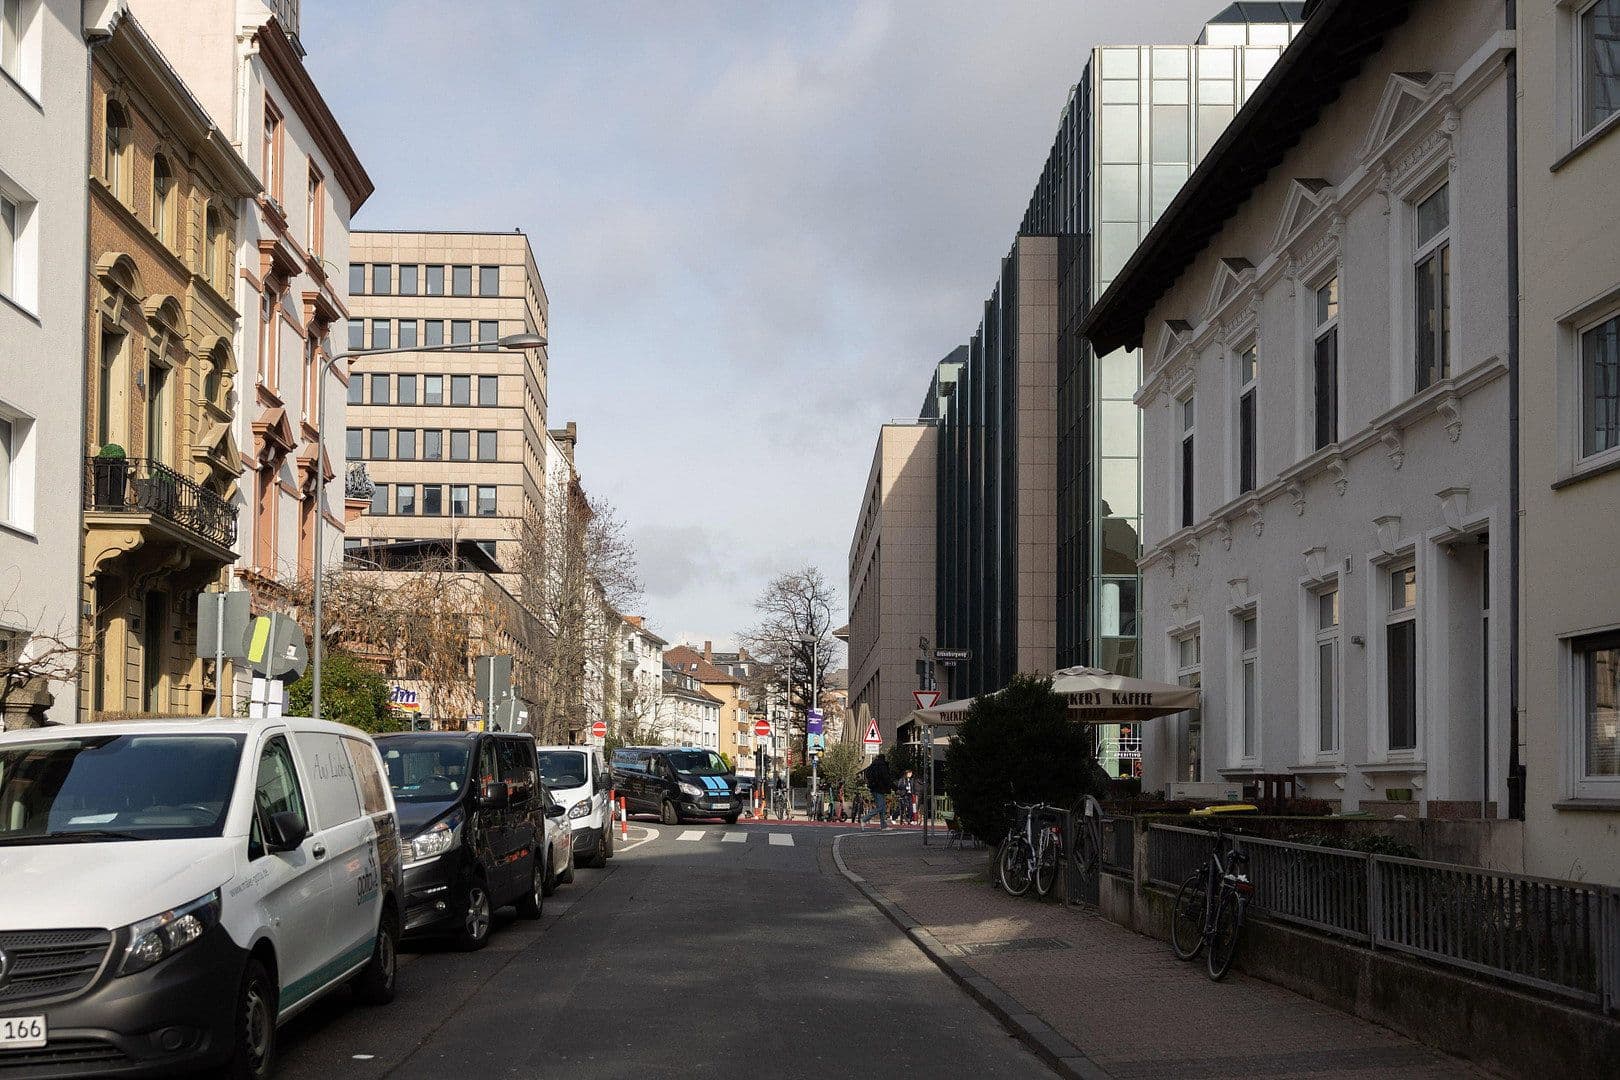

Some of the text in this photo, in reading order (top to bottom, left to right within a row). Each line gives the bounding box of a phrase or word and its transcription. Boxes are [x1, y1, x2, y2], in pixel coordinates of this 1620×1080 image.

[390, 685, 416, 702] dm
[1112, 692, 1153, 705] KAFFEE
[5, 1020, 41, 1039] 166
